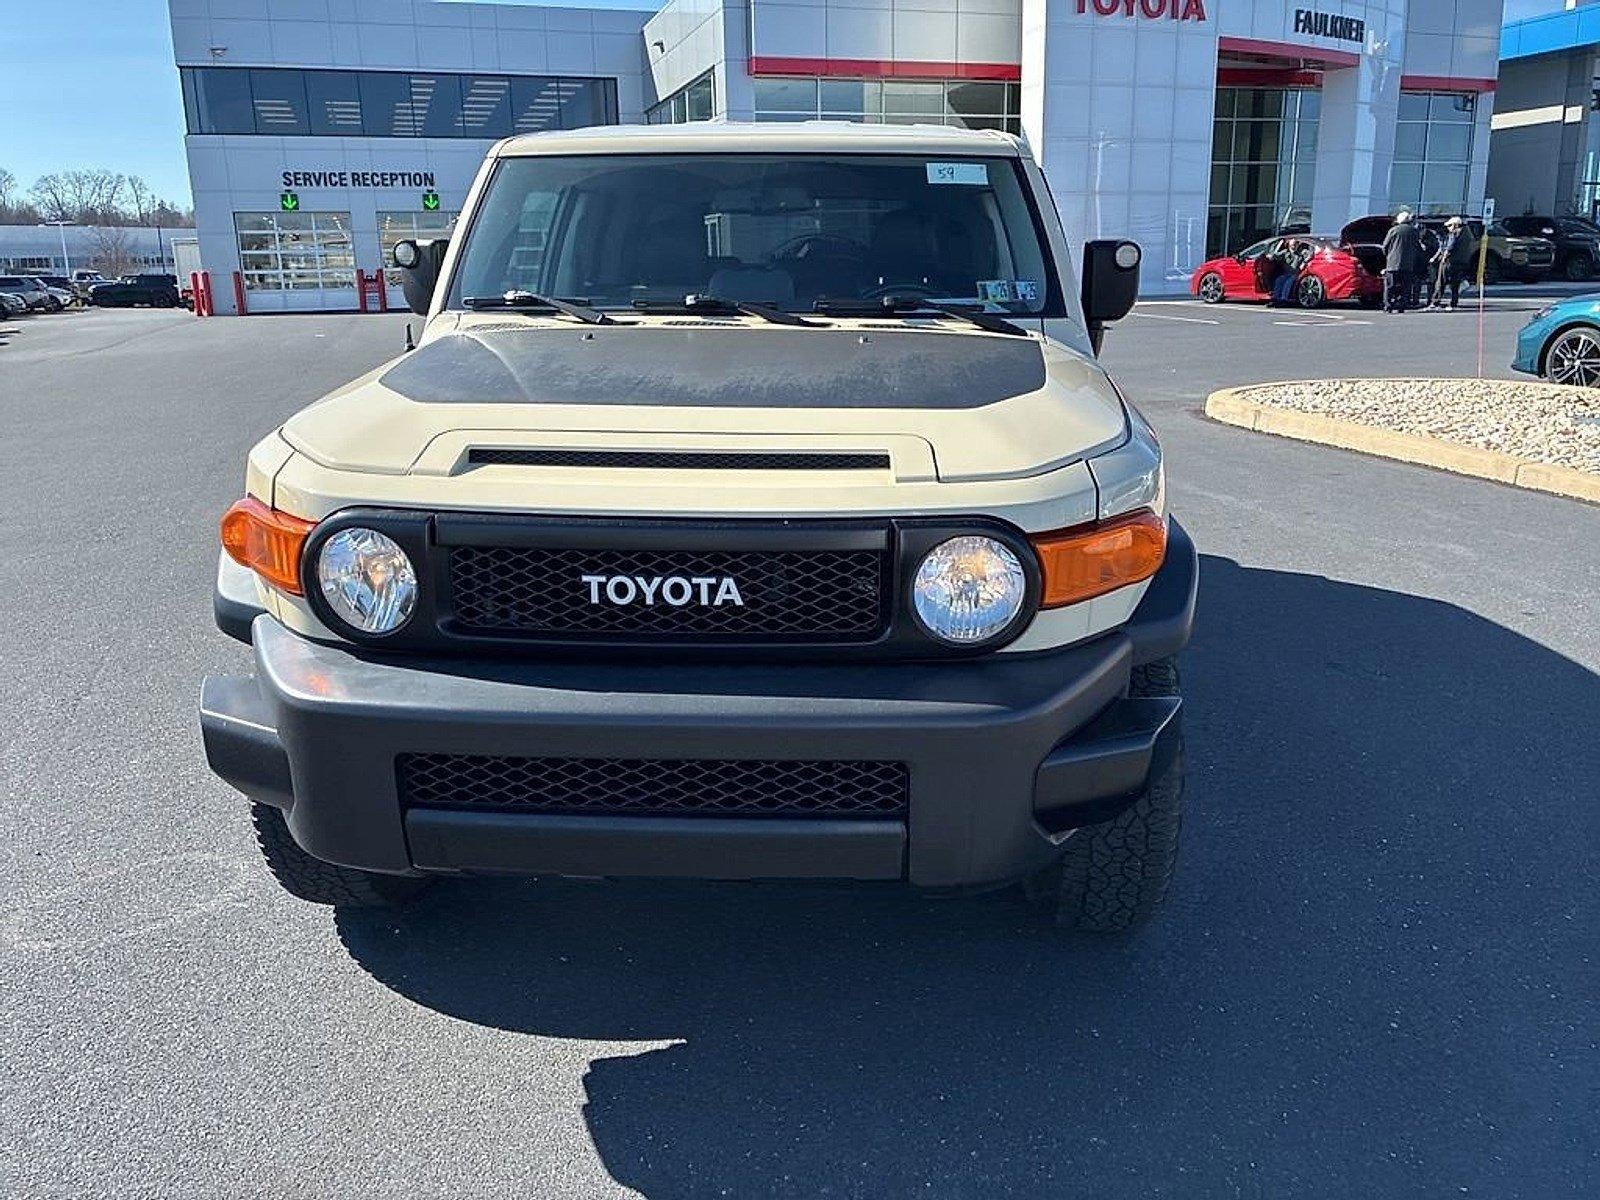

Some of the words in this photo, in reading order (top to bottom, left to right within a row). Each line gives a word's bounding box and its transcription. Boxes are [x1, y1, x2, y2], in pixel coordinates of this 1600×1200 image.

[1294, 9, 1364, 43] FAULKNER
[282, 171, 348, 187] SERVICE
[351, 172, 435, 187] RECEPTION
[581, 574, 744, 606] TOYOTA
